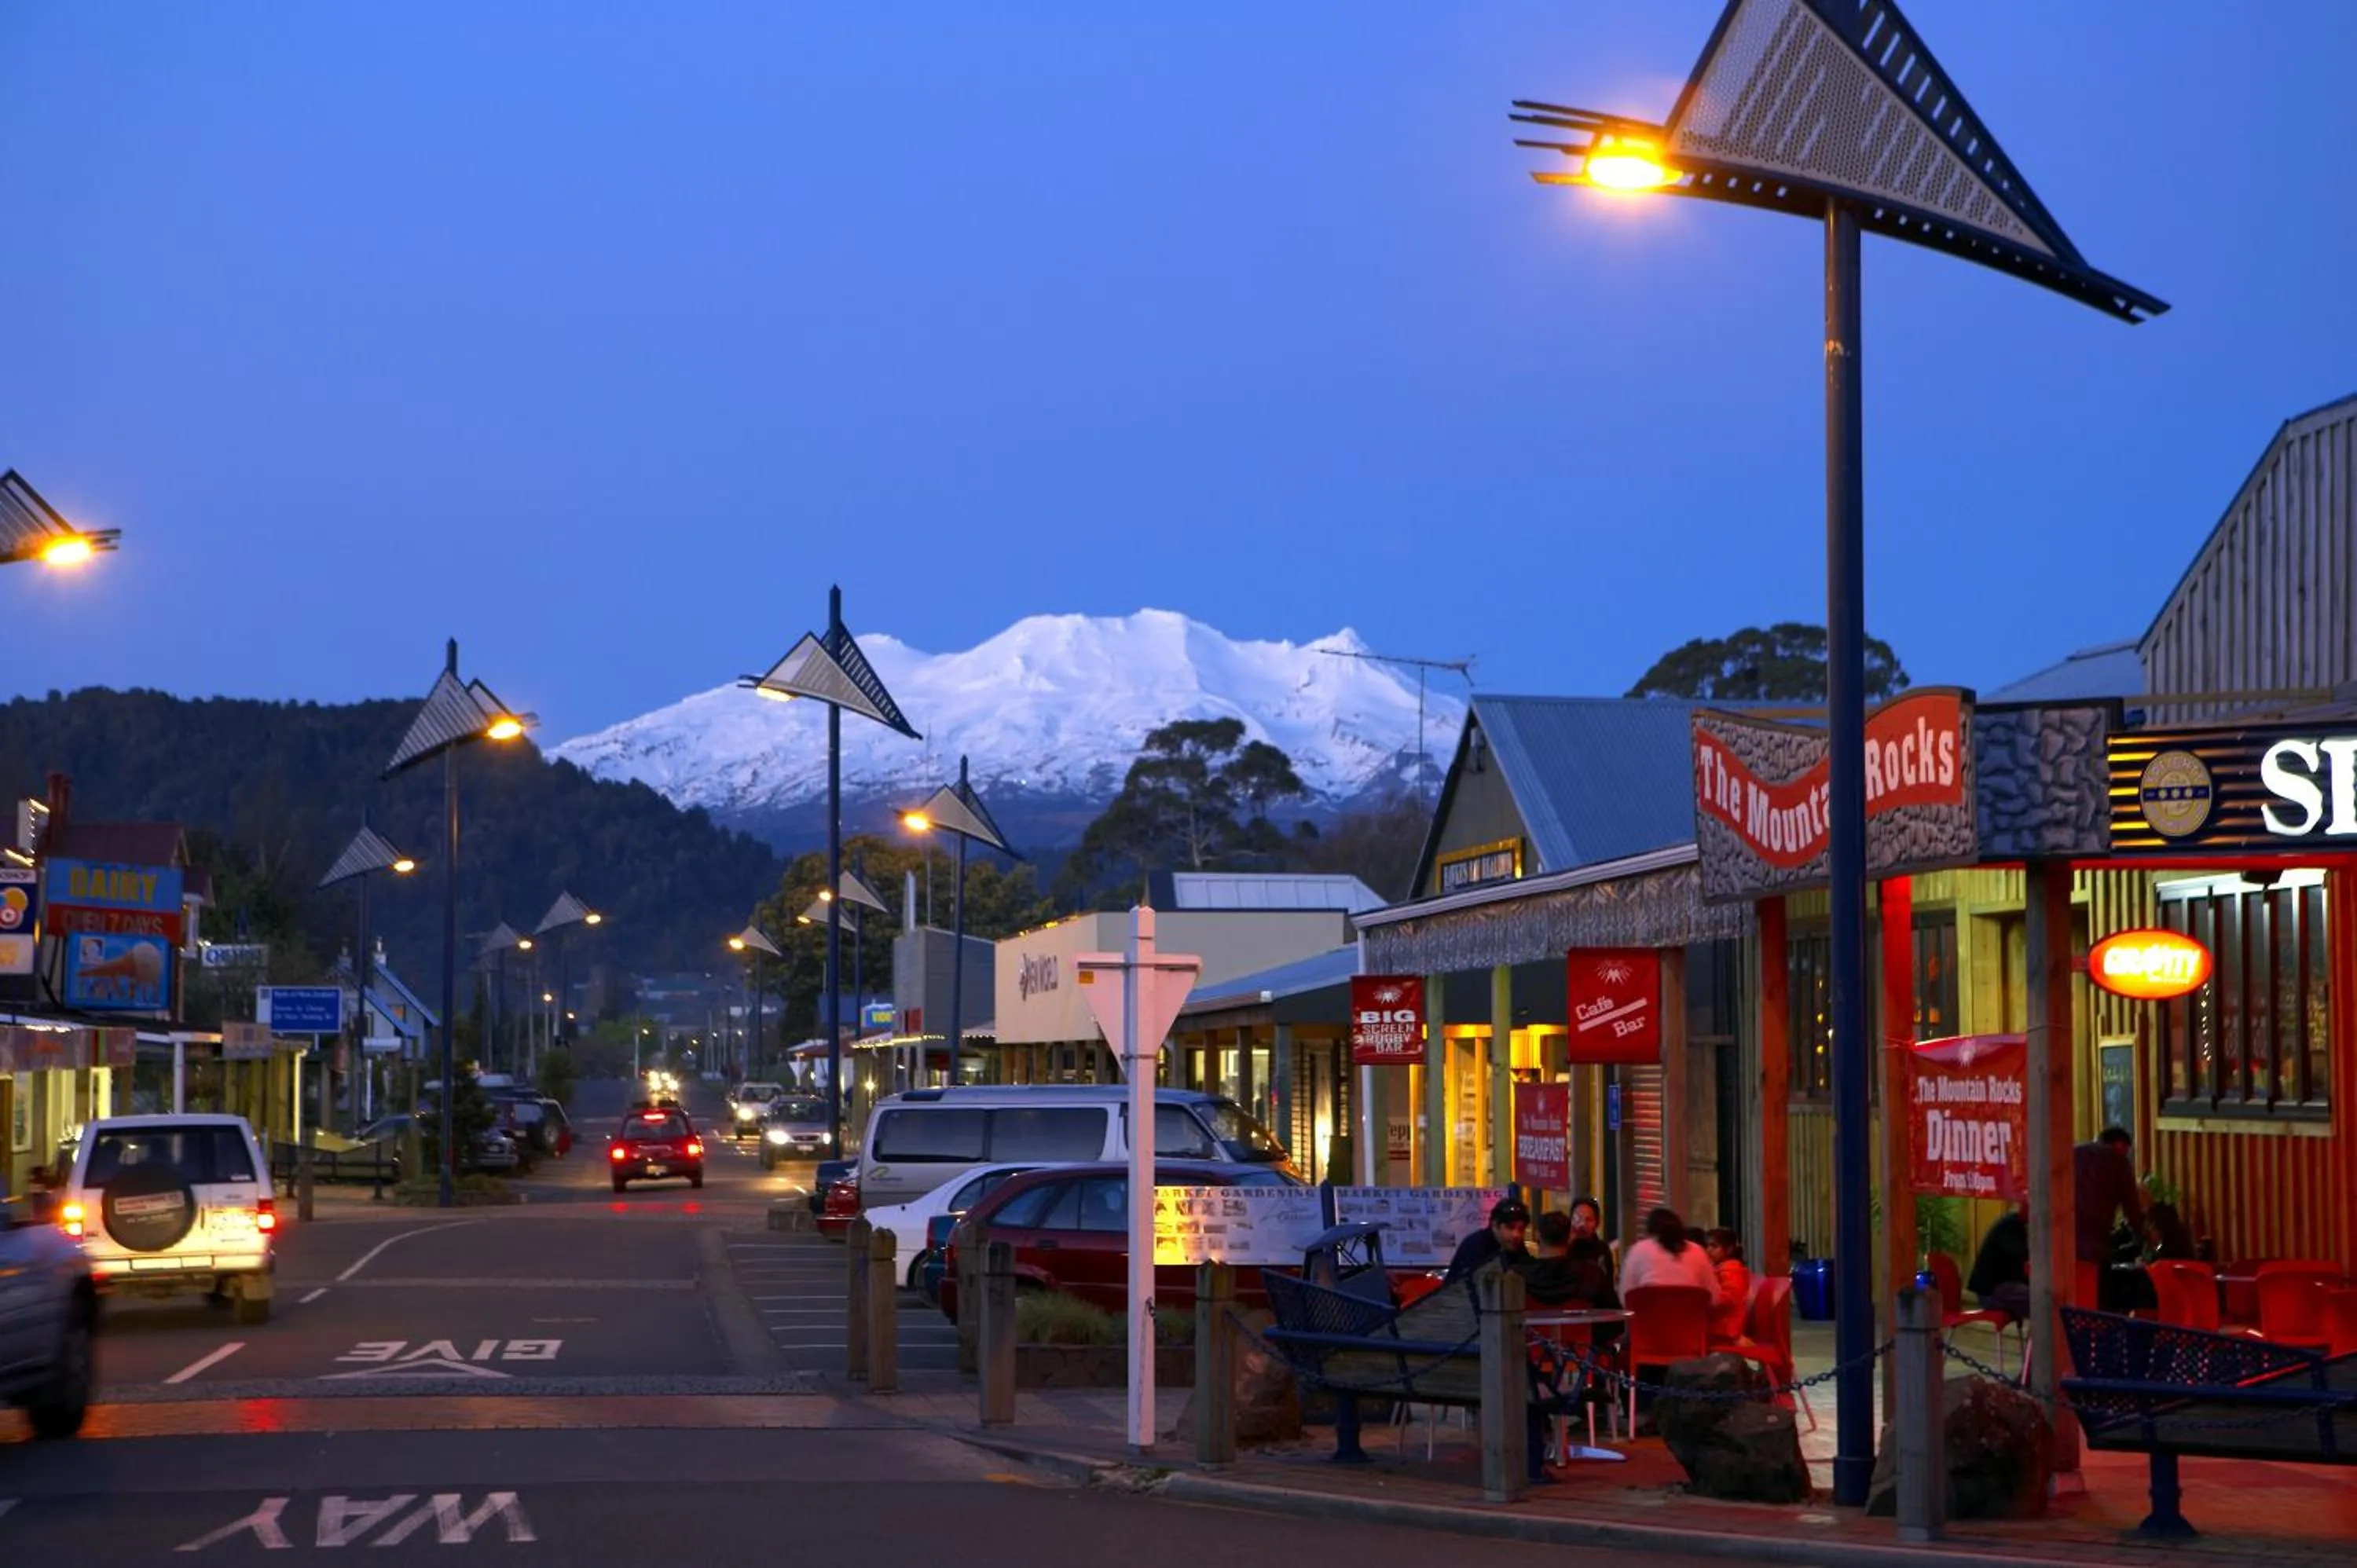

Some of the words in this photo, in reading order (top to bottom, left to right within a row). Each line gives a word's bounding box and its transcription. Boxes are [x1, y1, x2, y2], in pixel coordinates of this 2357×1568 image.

[1700, 745, 1741, 823] The
[1747, 781, 1831, 853] Mounta
[1864, 716, 1954, 802] Rocks
[70, 867, 157, 903] DAIRY
[108, 913, 119, 932] 7
[123, 915, 163, 934] DAYS
[1360, 1010, 1416, 1024] BIG
[1613, 1017, 1646, 1038] Bar
[1362, 1024, 1415, 1035] SCREEN
[1926, 1109, 2011, 1164] Dinner
[1221, 1188, 1315, 1198] GARDENING
[335, 1339, 565, 1362] GIVE
[172, 1492, 539, 1553] WAY
